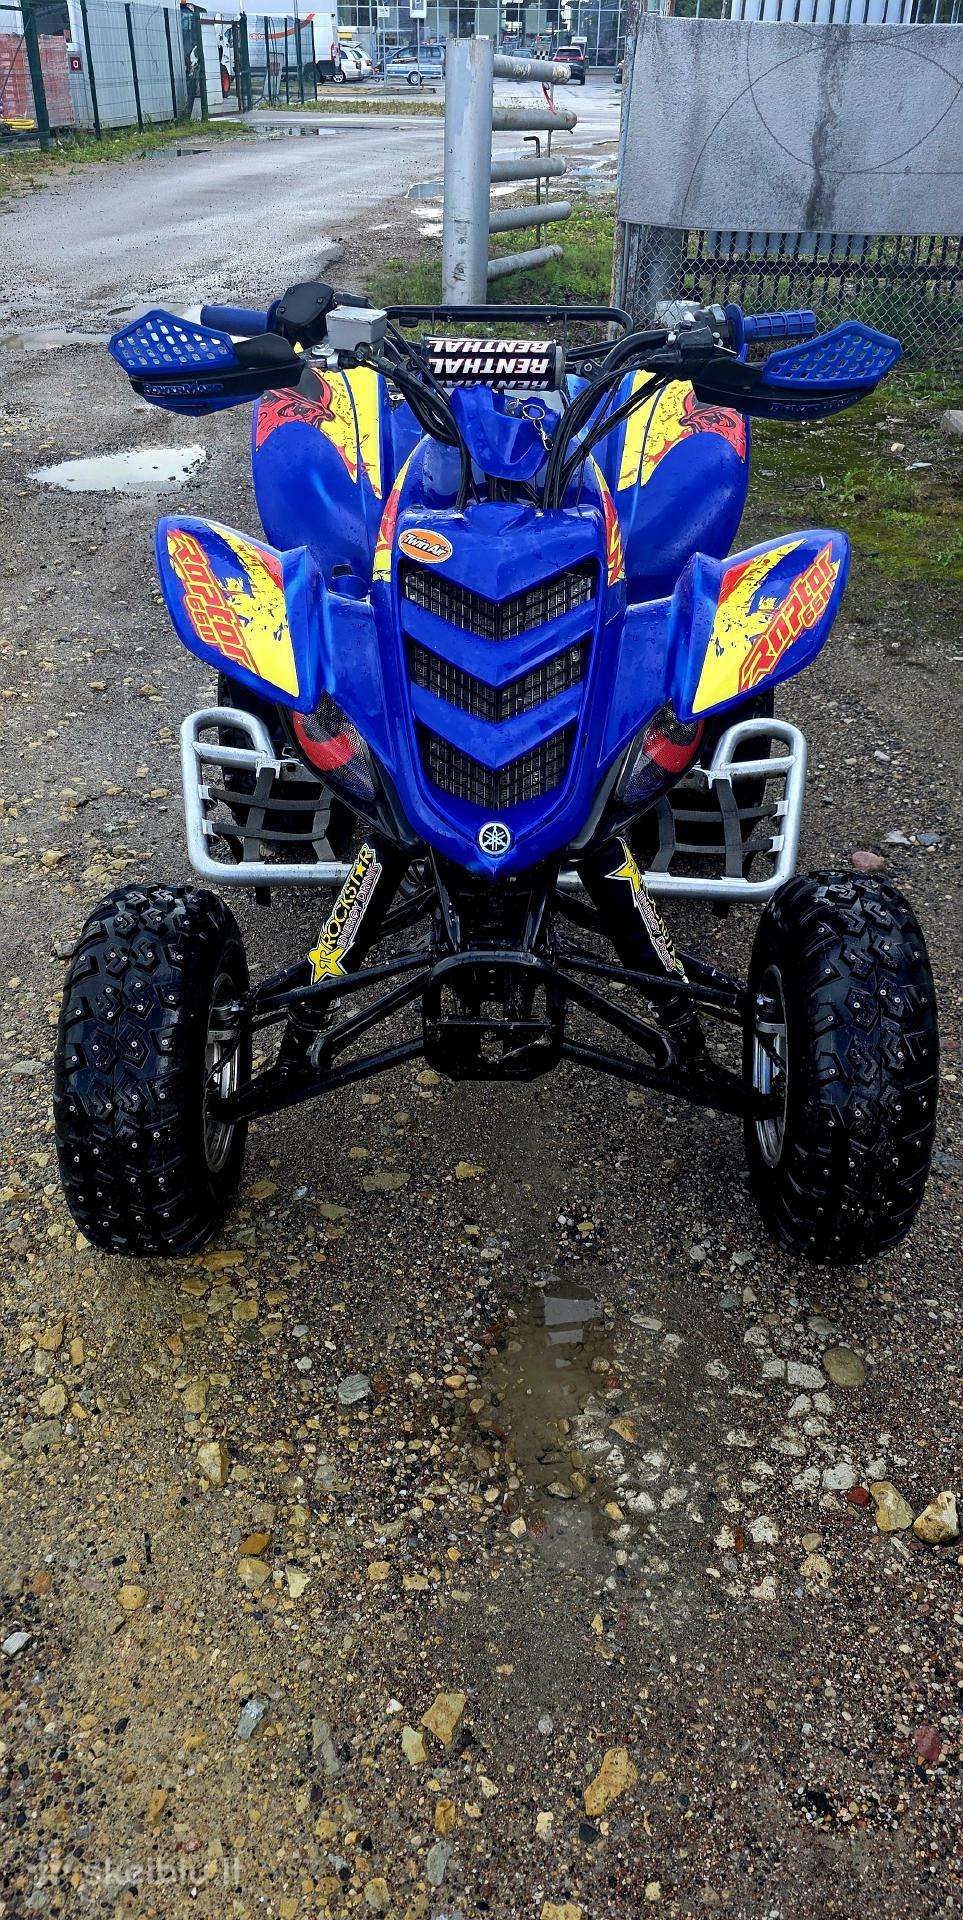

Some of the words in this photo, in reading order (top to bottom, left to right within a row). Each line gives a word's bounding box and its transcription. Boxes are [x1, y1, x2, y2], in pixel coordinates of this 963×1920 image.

[429, 340, 550, 353] RENTHAL
[429, 358, 550, 374] RENTHAL
[337, 902, 362, 946] ENERGY
[356, 862, 379, 902] DRINK
